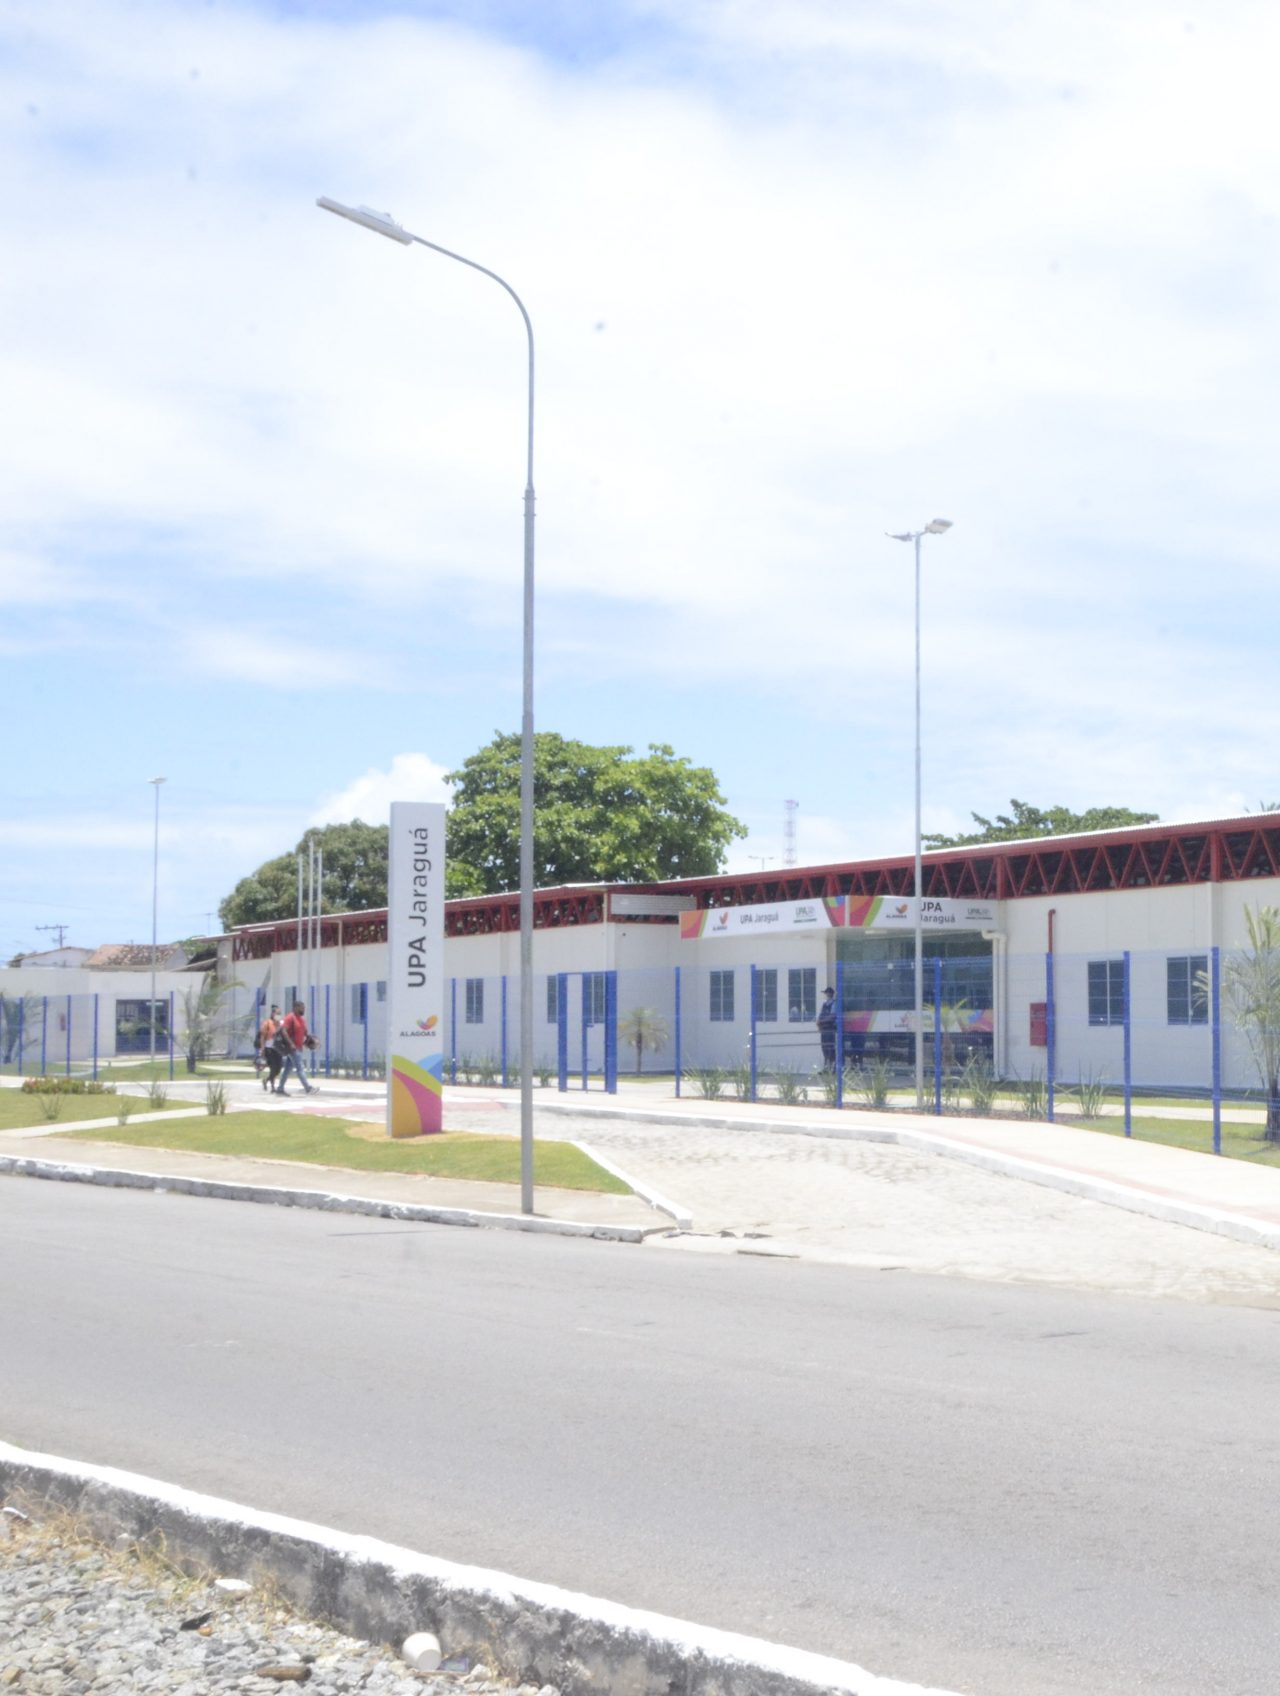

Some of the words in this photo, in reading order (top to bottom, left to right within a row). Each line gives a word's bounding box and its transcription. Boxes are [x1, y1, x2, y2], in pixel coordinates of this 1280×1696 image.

[408, 826, 432, 928] Jaraguá
[739, 914, 753, 925] UPA
[406, 936, 427, 988] UPA
